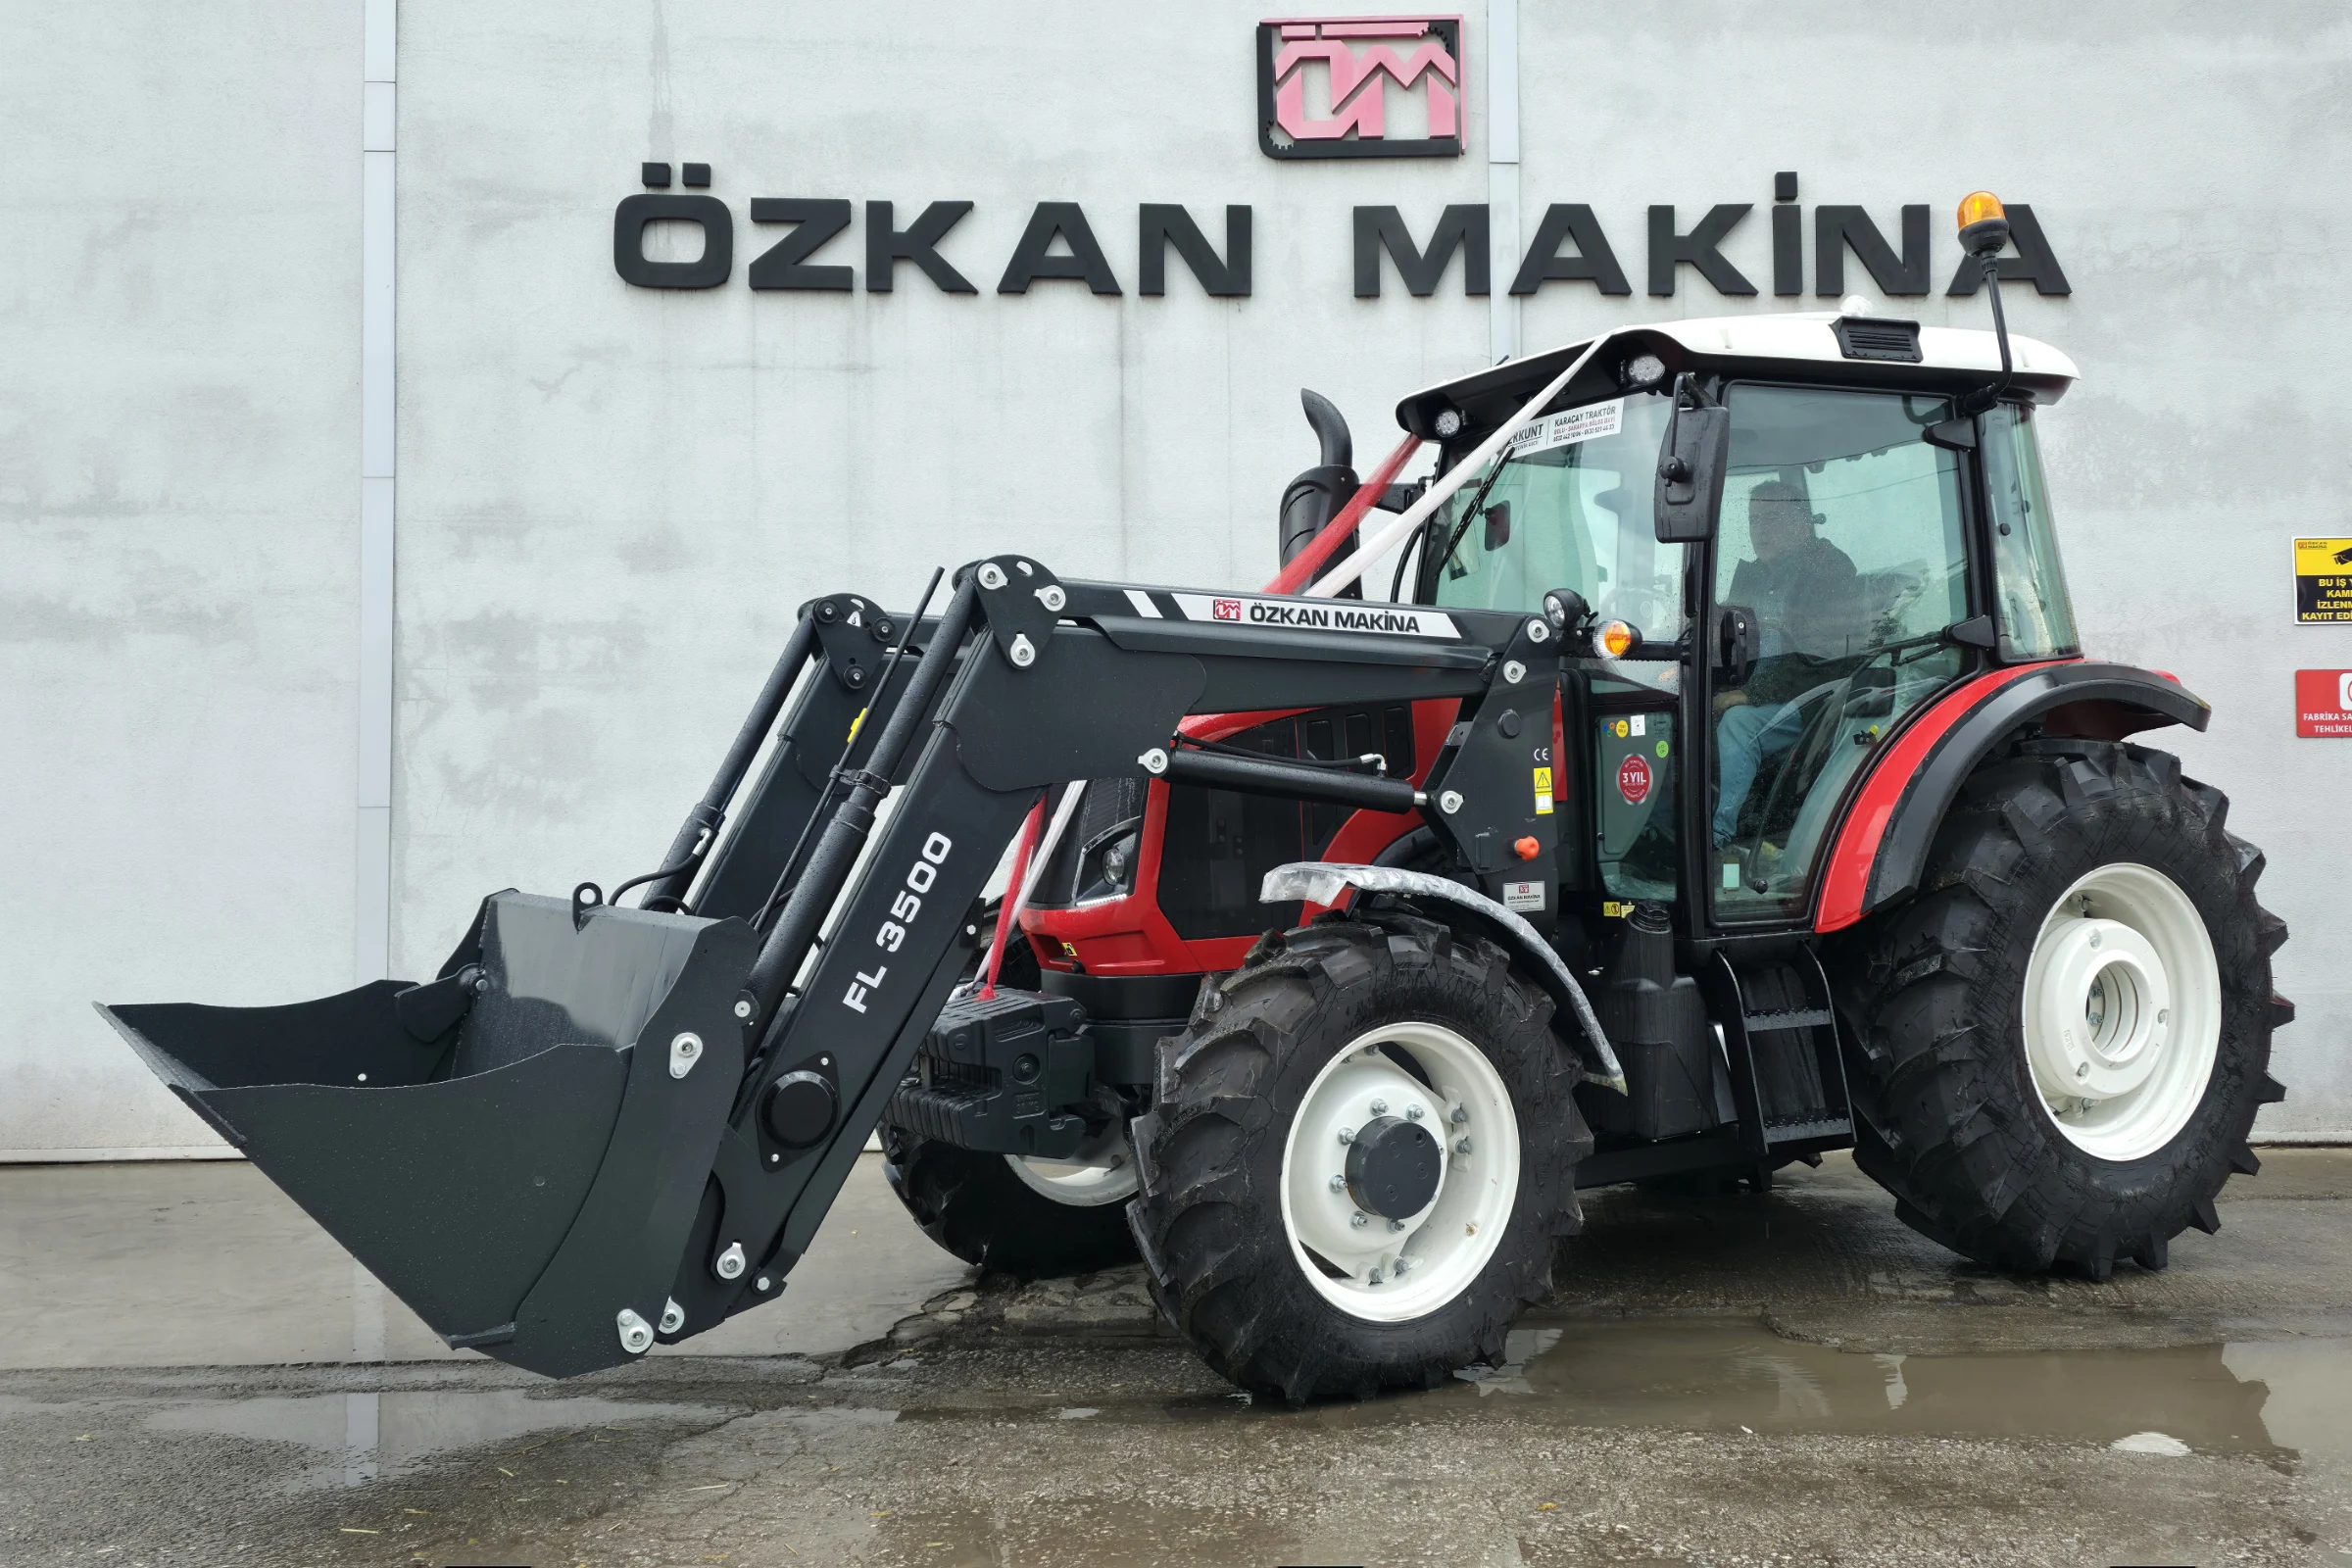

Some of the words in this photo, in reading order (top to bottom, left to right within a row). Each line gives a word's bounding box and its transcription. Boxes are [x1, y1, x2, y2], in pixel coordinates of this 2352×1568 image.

[613, 162, 1251, 297] ÖZKAN
[1353, 171, 2072, 298] MAKİNA
[1554, 413, 1585, 427] KARAÇAY
[1585, 405, 1616, 419] TRAKTÖR
[2319, 578, 2333, 587] BU
[2336, 576, 2347, 588] İŞ
[2327, 589, 2352, 598] KAM
[1250, 602, 1329, 627] ÖZKAN
[1334, 610, 1421, 633] MAKİNA
[2302, 612, 2333, 620] KAYIT
[2303, 711, 2340, 721] FABRİKA
[1622, 772, 1628, 783] 3
[1630, 772, 1646, 783] YIL
[842, 965, 888, 1014] FL
[875, 831, 953, 953] 3500
